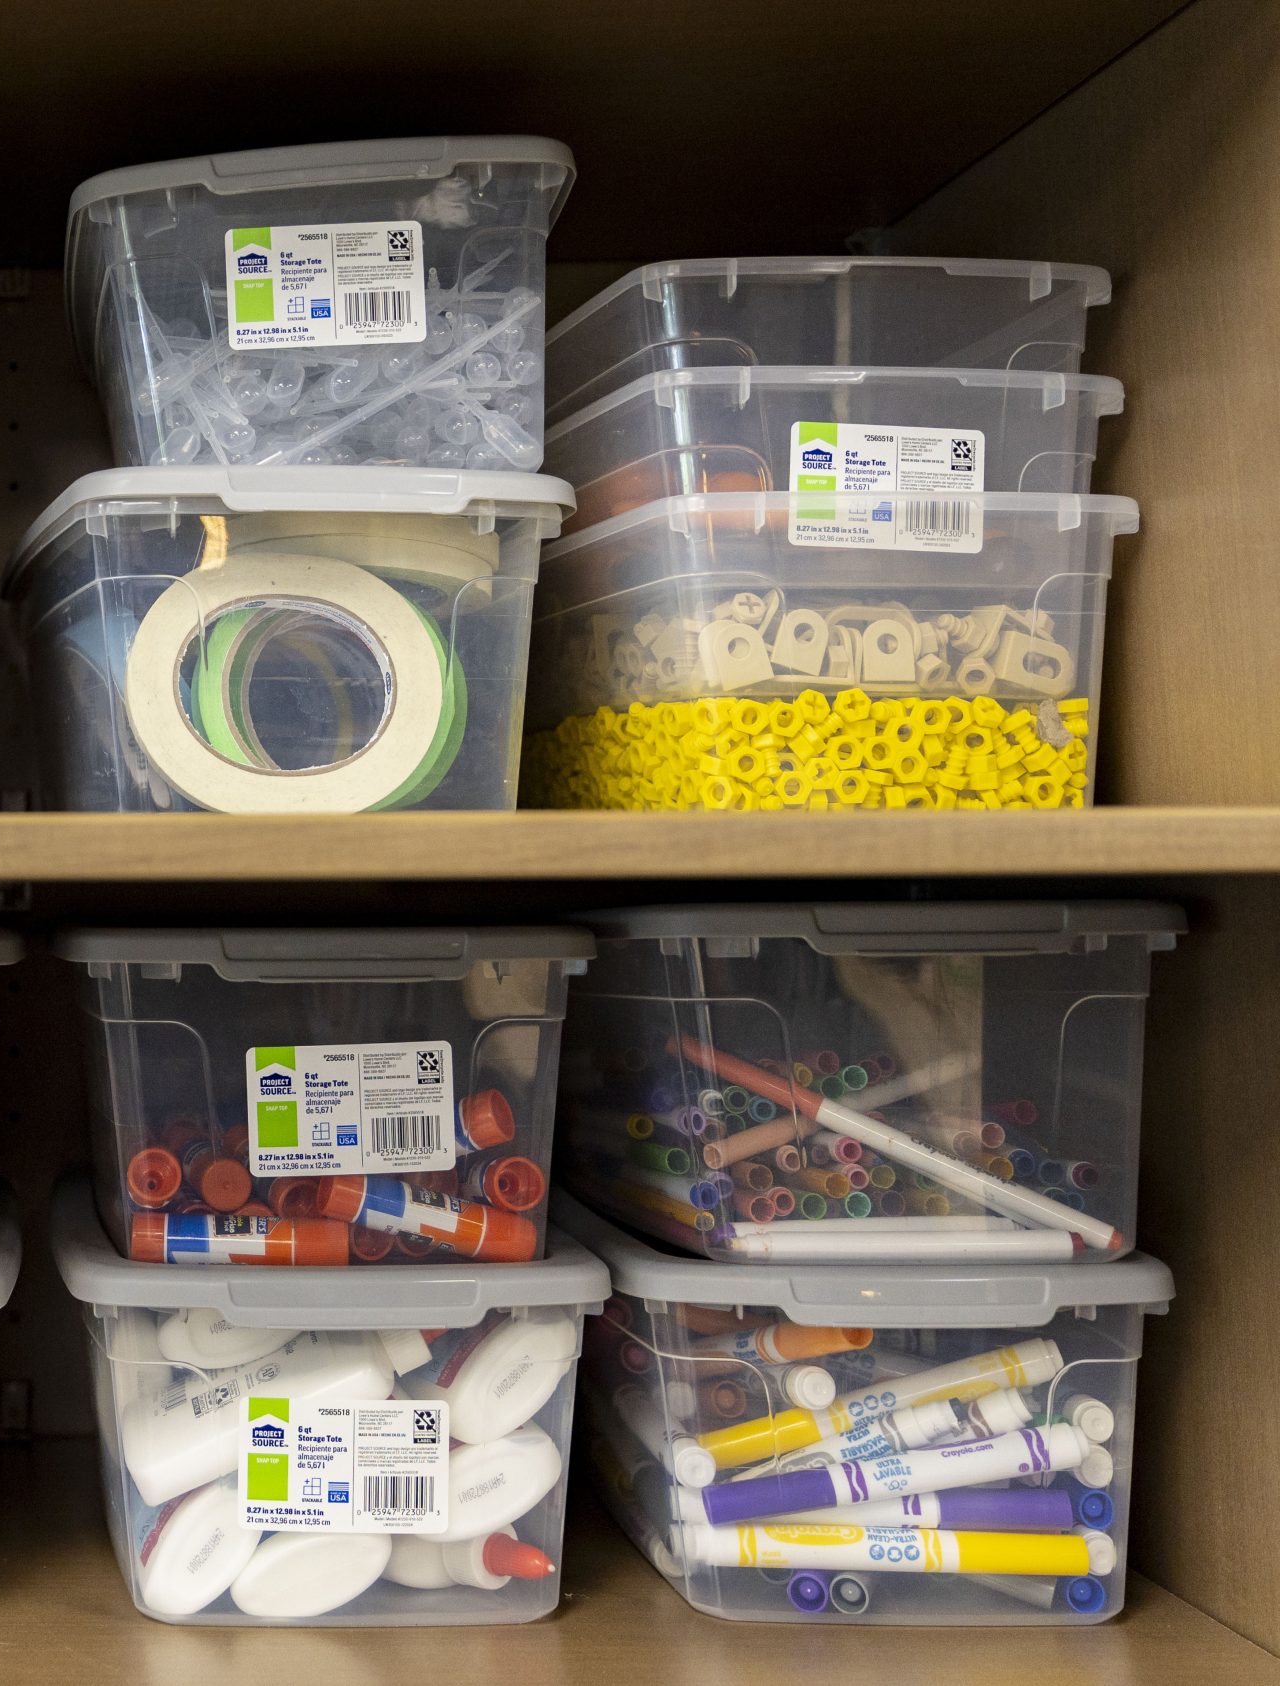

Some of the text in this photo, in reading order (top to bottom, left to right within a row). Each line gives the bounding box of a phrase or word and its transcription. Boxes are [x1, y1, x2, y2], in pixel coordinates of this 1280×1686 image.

[280, 259, 306, 267] Storage
[280, 268, 312, 276] Recipiente
[281, 275, 315, 283] almacenaje
[804, 453, 830, 461] PROJECT
[845, 458, 886, 467] Storage Tote
[845, 467, 876, 476] Recipiente
[844, 475, 878, 484] almacenaje
[310, 1072, 318, 1080] qt
[262, 1078, 289, 1086] PROJECT
[305, 1080, 332, 1089] Storage
[305, 1090, 338, 1098] Recipiente
[305, 1098, 341, 1106] almacenaje
[304, 1426, 312, 1434] qt
[298, 1434, 342, 1443] Storage Tote
[298, 1444, 331, 1453] Recipiente
[941, 1443, 994, 1458] Crayola.com
[297, 1453, 334, 1461] almacenaje
[876, 1458, 902, 1469] ULTRA
[873, 1465, 912, 1481] LAVABLE
[867, 1533, 918, 1543] ULTRA-CLEAN
